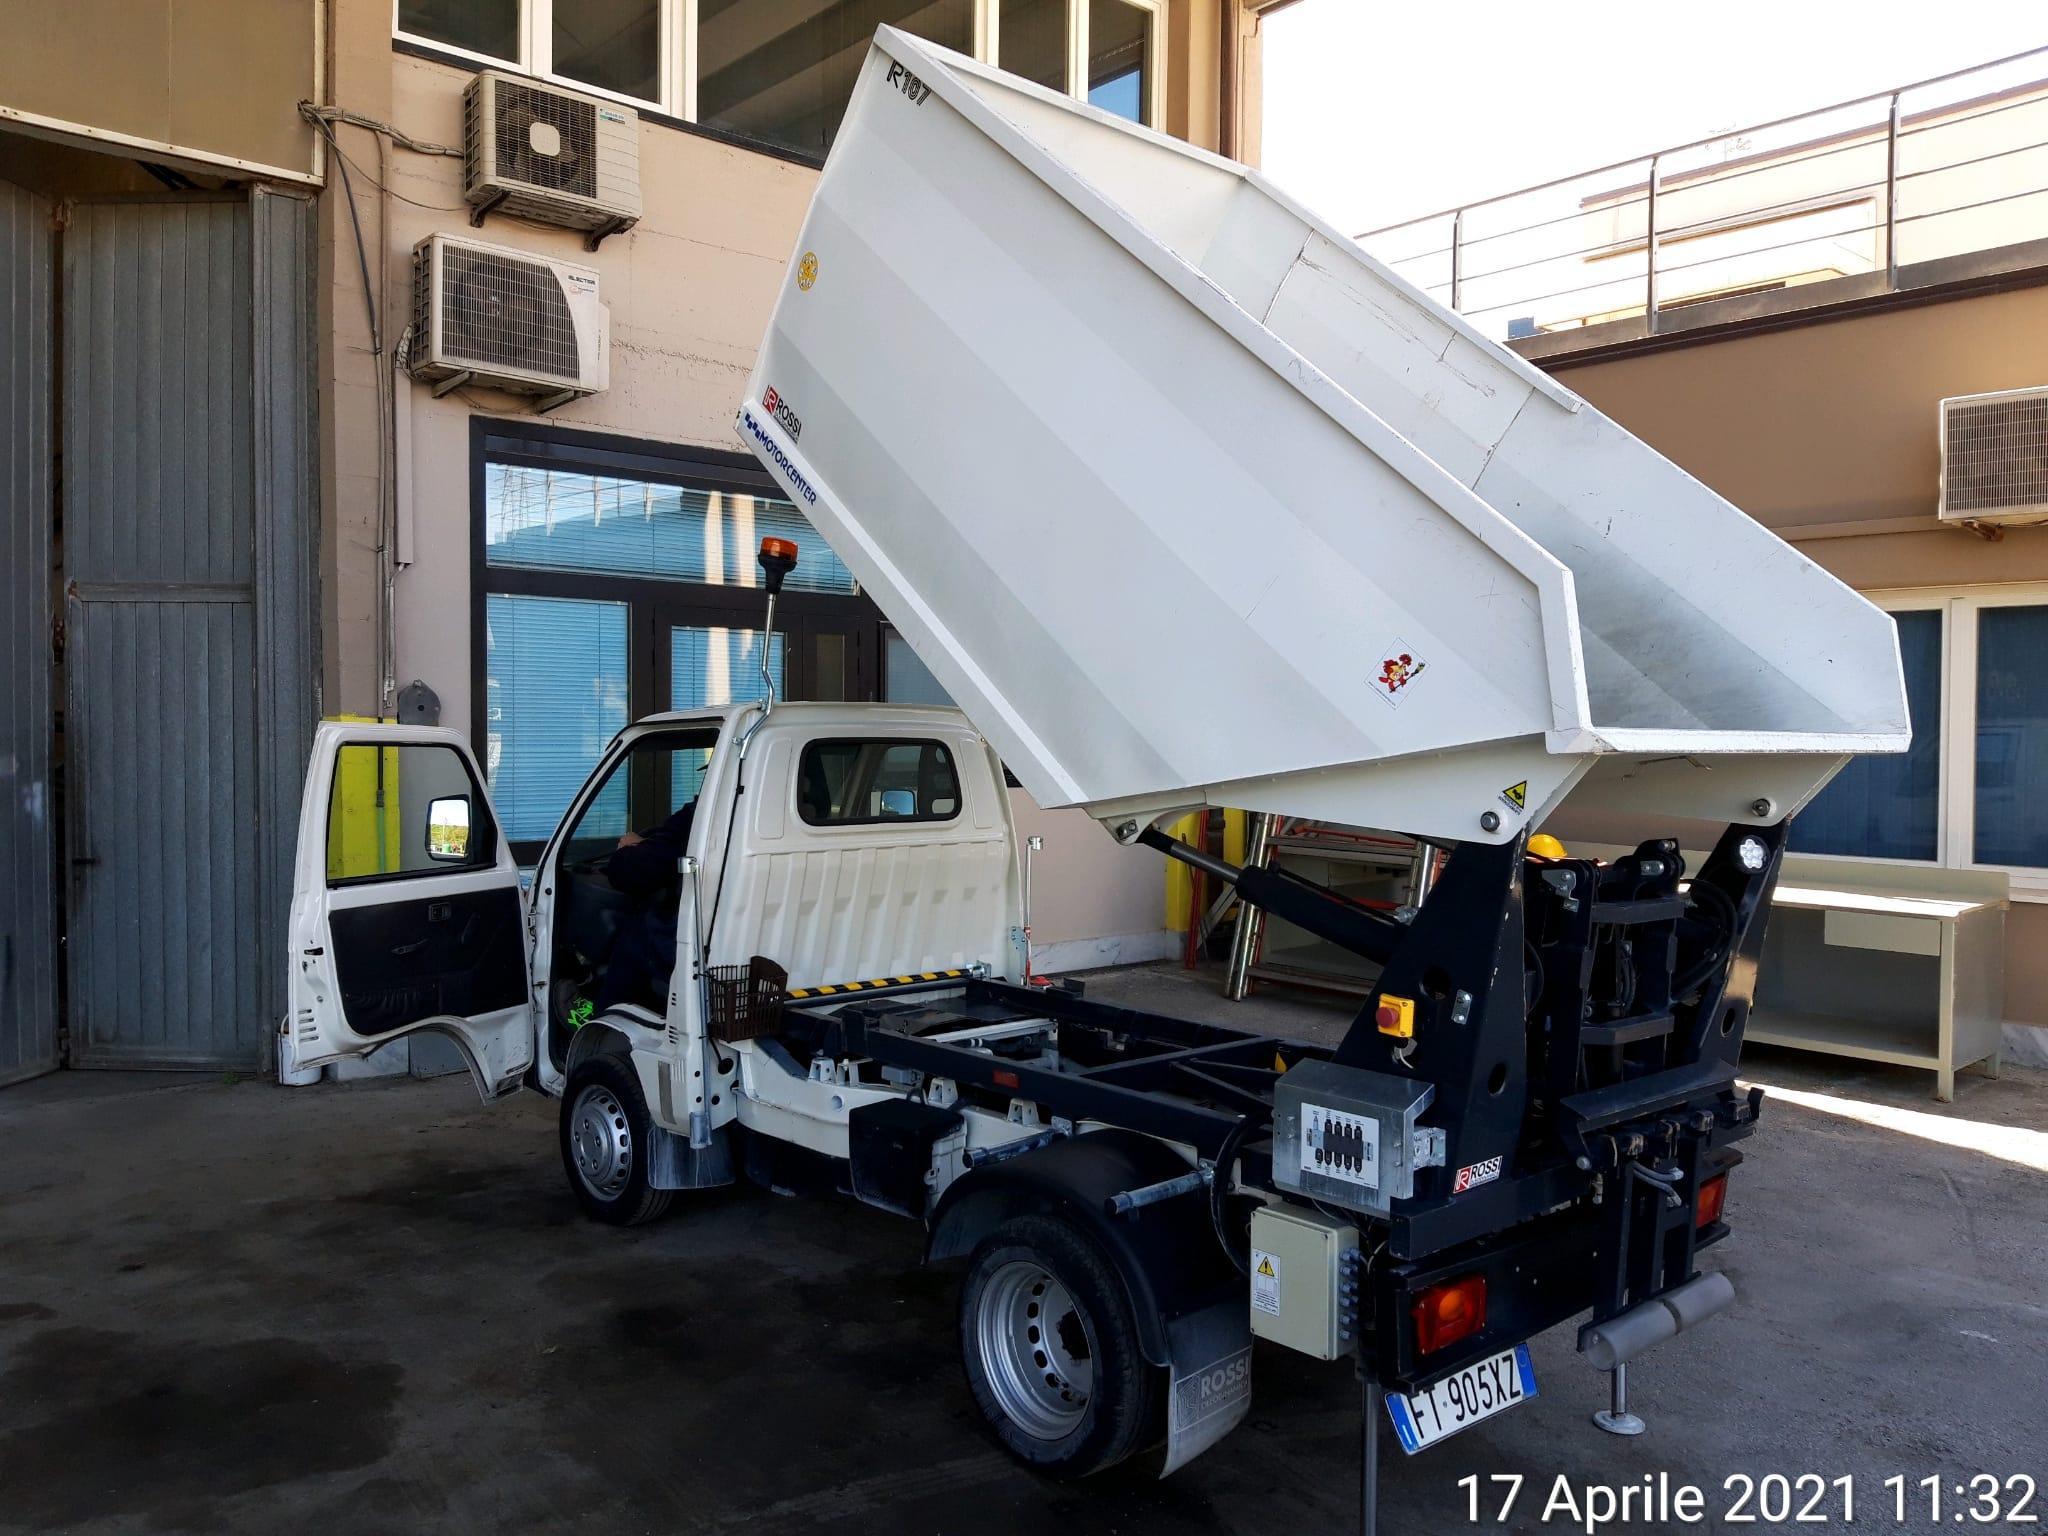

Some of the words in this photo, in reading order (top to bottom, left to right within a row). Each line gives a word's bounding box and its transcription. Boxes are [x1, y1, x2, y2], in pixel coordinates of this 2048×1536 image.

[886, 59, 932, 106] R107
[776, 398, 802, 437] ROSSI
[759, 430, 817, 506] MOTORCENTER
[1470, 1157, 1502, 1179] ROSSI
[1201, 1355, 1249, 1400] ROSSI
